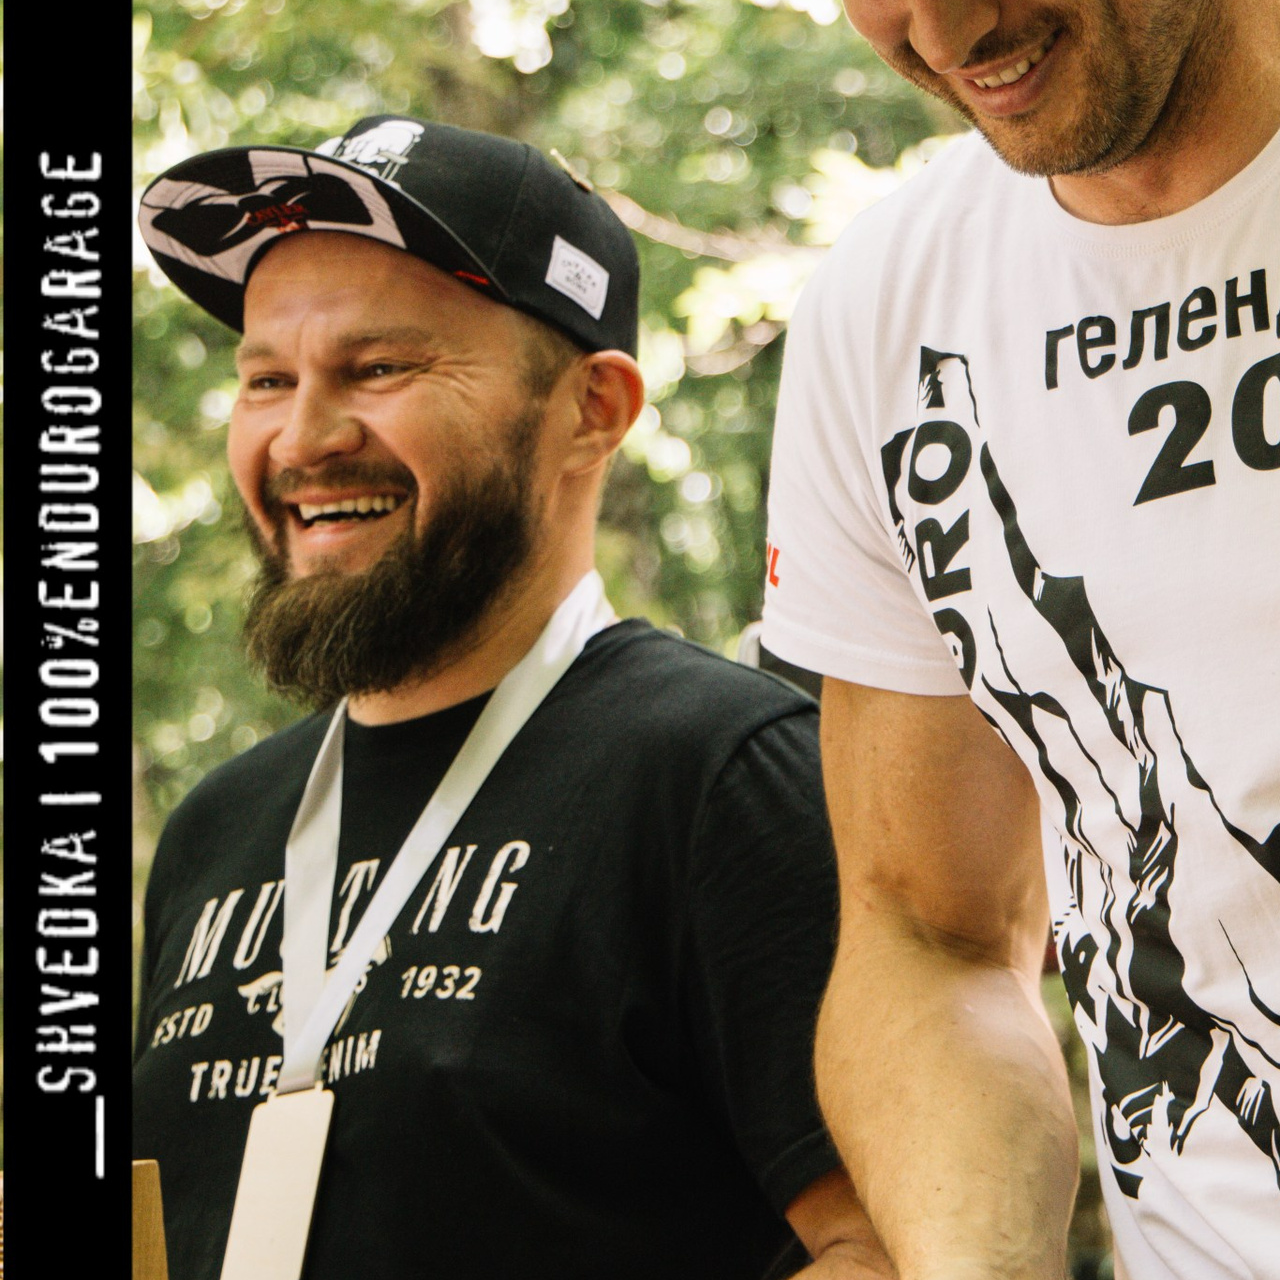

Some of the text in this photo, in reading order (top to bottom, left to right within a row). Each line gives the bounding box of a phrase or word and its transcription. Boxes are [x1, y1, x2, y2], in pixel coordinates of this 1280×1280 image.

[174, 840, 531, 990] MUTNG
[400, 964, 482, 1000] 1932
[189, 1055, 283, 1103] TRUE
